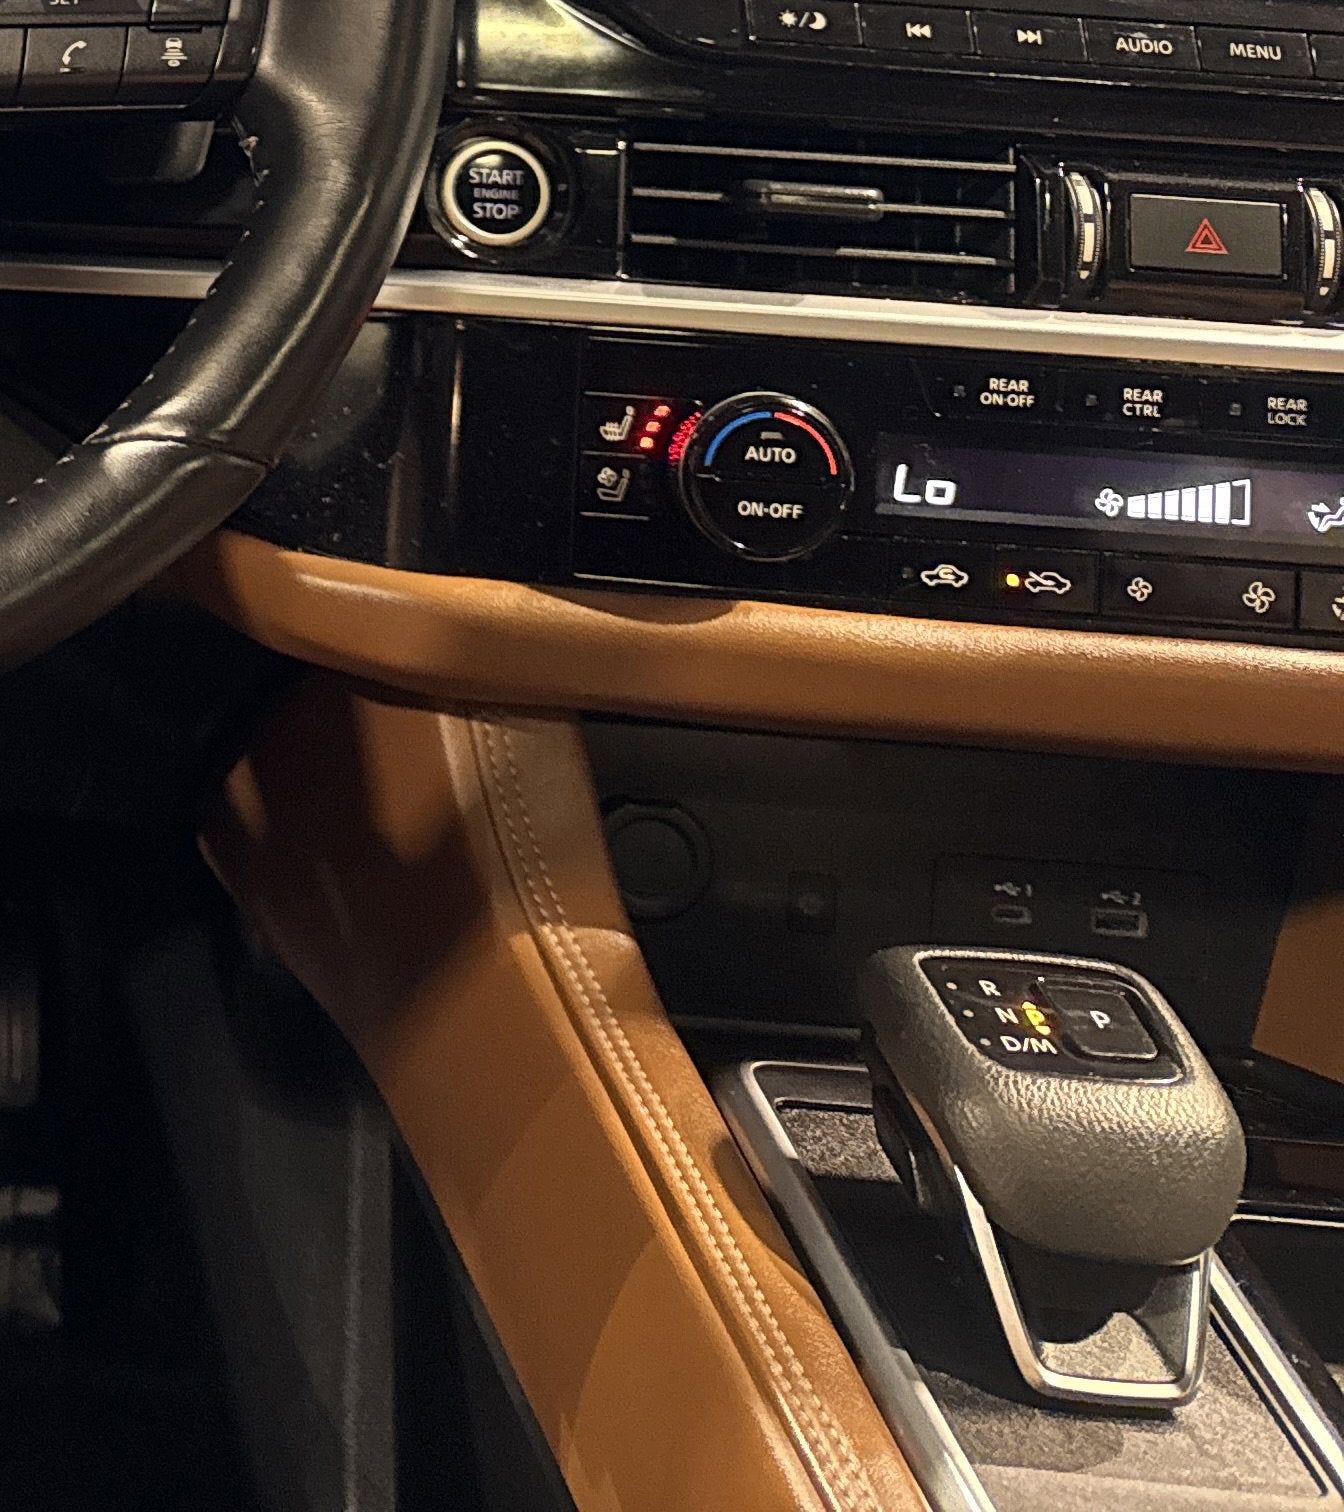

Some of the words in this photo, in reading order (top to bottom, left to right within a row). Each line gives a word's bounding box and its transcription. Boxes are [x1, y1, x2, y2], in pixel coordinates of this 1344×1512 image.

[1115, 37, 1174, 56] AUDIO
[1229, 43, 1283, 62] MENU
[468, 168, 525, 186] START
[473, 187, 519, 200] ENGINE
[472, 202, 520, 220] STOP
[988, 377, 1030, 393] REAR
[1122, 388, 1164, 404] REAR
[1267, 396, 1309, 413] REAR
[1121, 402, 1162, 419] CTRL
[1266, 410, 1308, 427] LOCK
[744, 445, 797, 464] AUTO
[978, 979, 1002, 997] R
[994, 1007, 1020, 1025] N
[1090, 1010, 1111, 1029] P
[999, 1035, 1059, 1055] D/M
